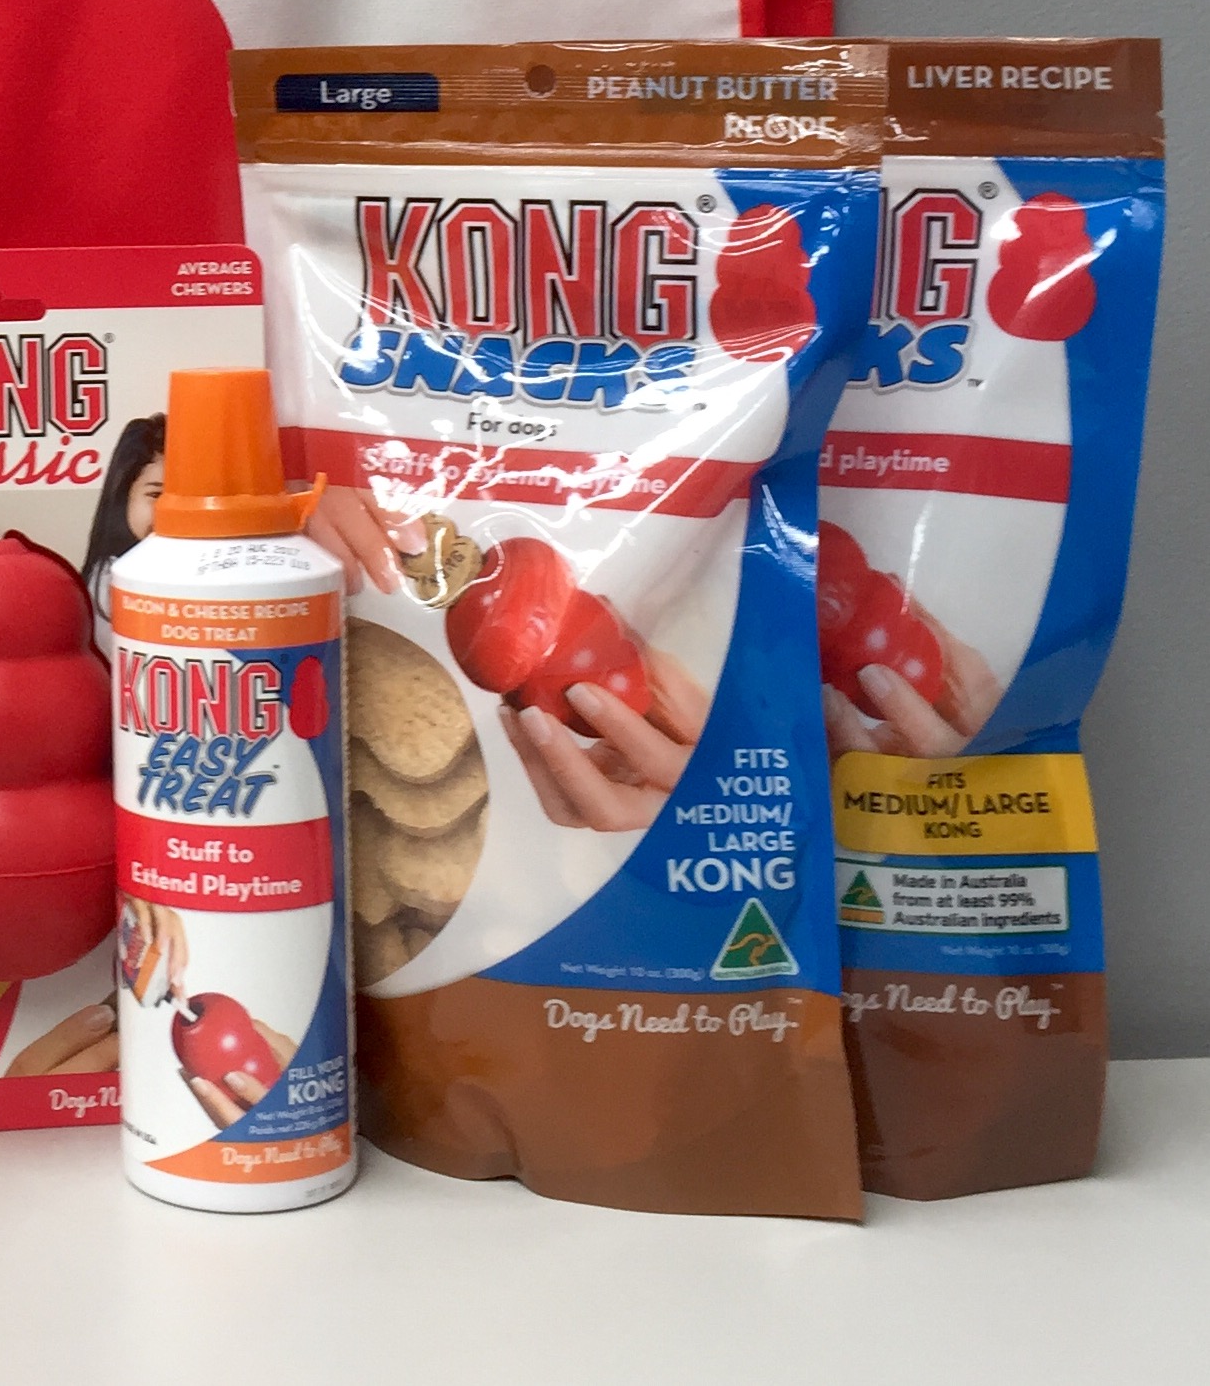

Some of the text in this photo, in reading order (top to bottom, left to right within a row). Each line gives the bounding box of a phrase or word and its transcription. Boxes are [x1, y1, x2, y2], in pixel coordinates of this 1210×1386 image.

[587, 76, 838, 101] PEANUT BUTTER
[907, 66, 1113, 91] LIVER RECIPE
[320, 81, 392, 109] Large
[724, 112, 838, 140] RECIPE
[177, 261, 253, 275] AVERAGE
[356, 196, 699, 348] KONG
[171, 281, 253, 296] CHEWERS
[466, 412, 499, 432] For
[840, 446, 950, 476] playtime
[182, 603, 251, 620] CHEESE
[253, 601, 310, 620] RECIPE
[161, 624, 258, 642] DOG TREAT
[118, 647, 284, 741] KONG
[148, 733, 271, 777] EASY
[733, 748, 790, 769] FITS
[138, 766, 278, 817] TREAT
[715, 775, 792, 797] YOUR
[926, 772, 967, 790] FITS
[675, 801, 793, 827] MEDIUM/
[843, 791, 1052, 819] MEDIUM/ LARGE
[707, 830, 797, 853] LARGE
[923, 821, 983, 840] KONG
[167, 837, 255, 864] Stuff to
[131, 861, 303, 903] Extend Playtime
[666, 856, 796, 893] KONG
[892, 874, 1028, 889] Made in Australia
[892, 892, 1036, 908] from at least 99%
[892, 910, 1062, 930] Australian ingredients
[884, 983, 958, 1013] Need
[960, 986, 992, 1016] to
[543, 998, 617, 1042] Dogs
[617, 1002, 691, 1034] Need
[692, 1004, 725, 1033] to
[288, 1065, 317, 1081] FILL
[288, 1070, 347, 1105] KONG
[48, 1088, 100, 1119] Dogs
